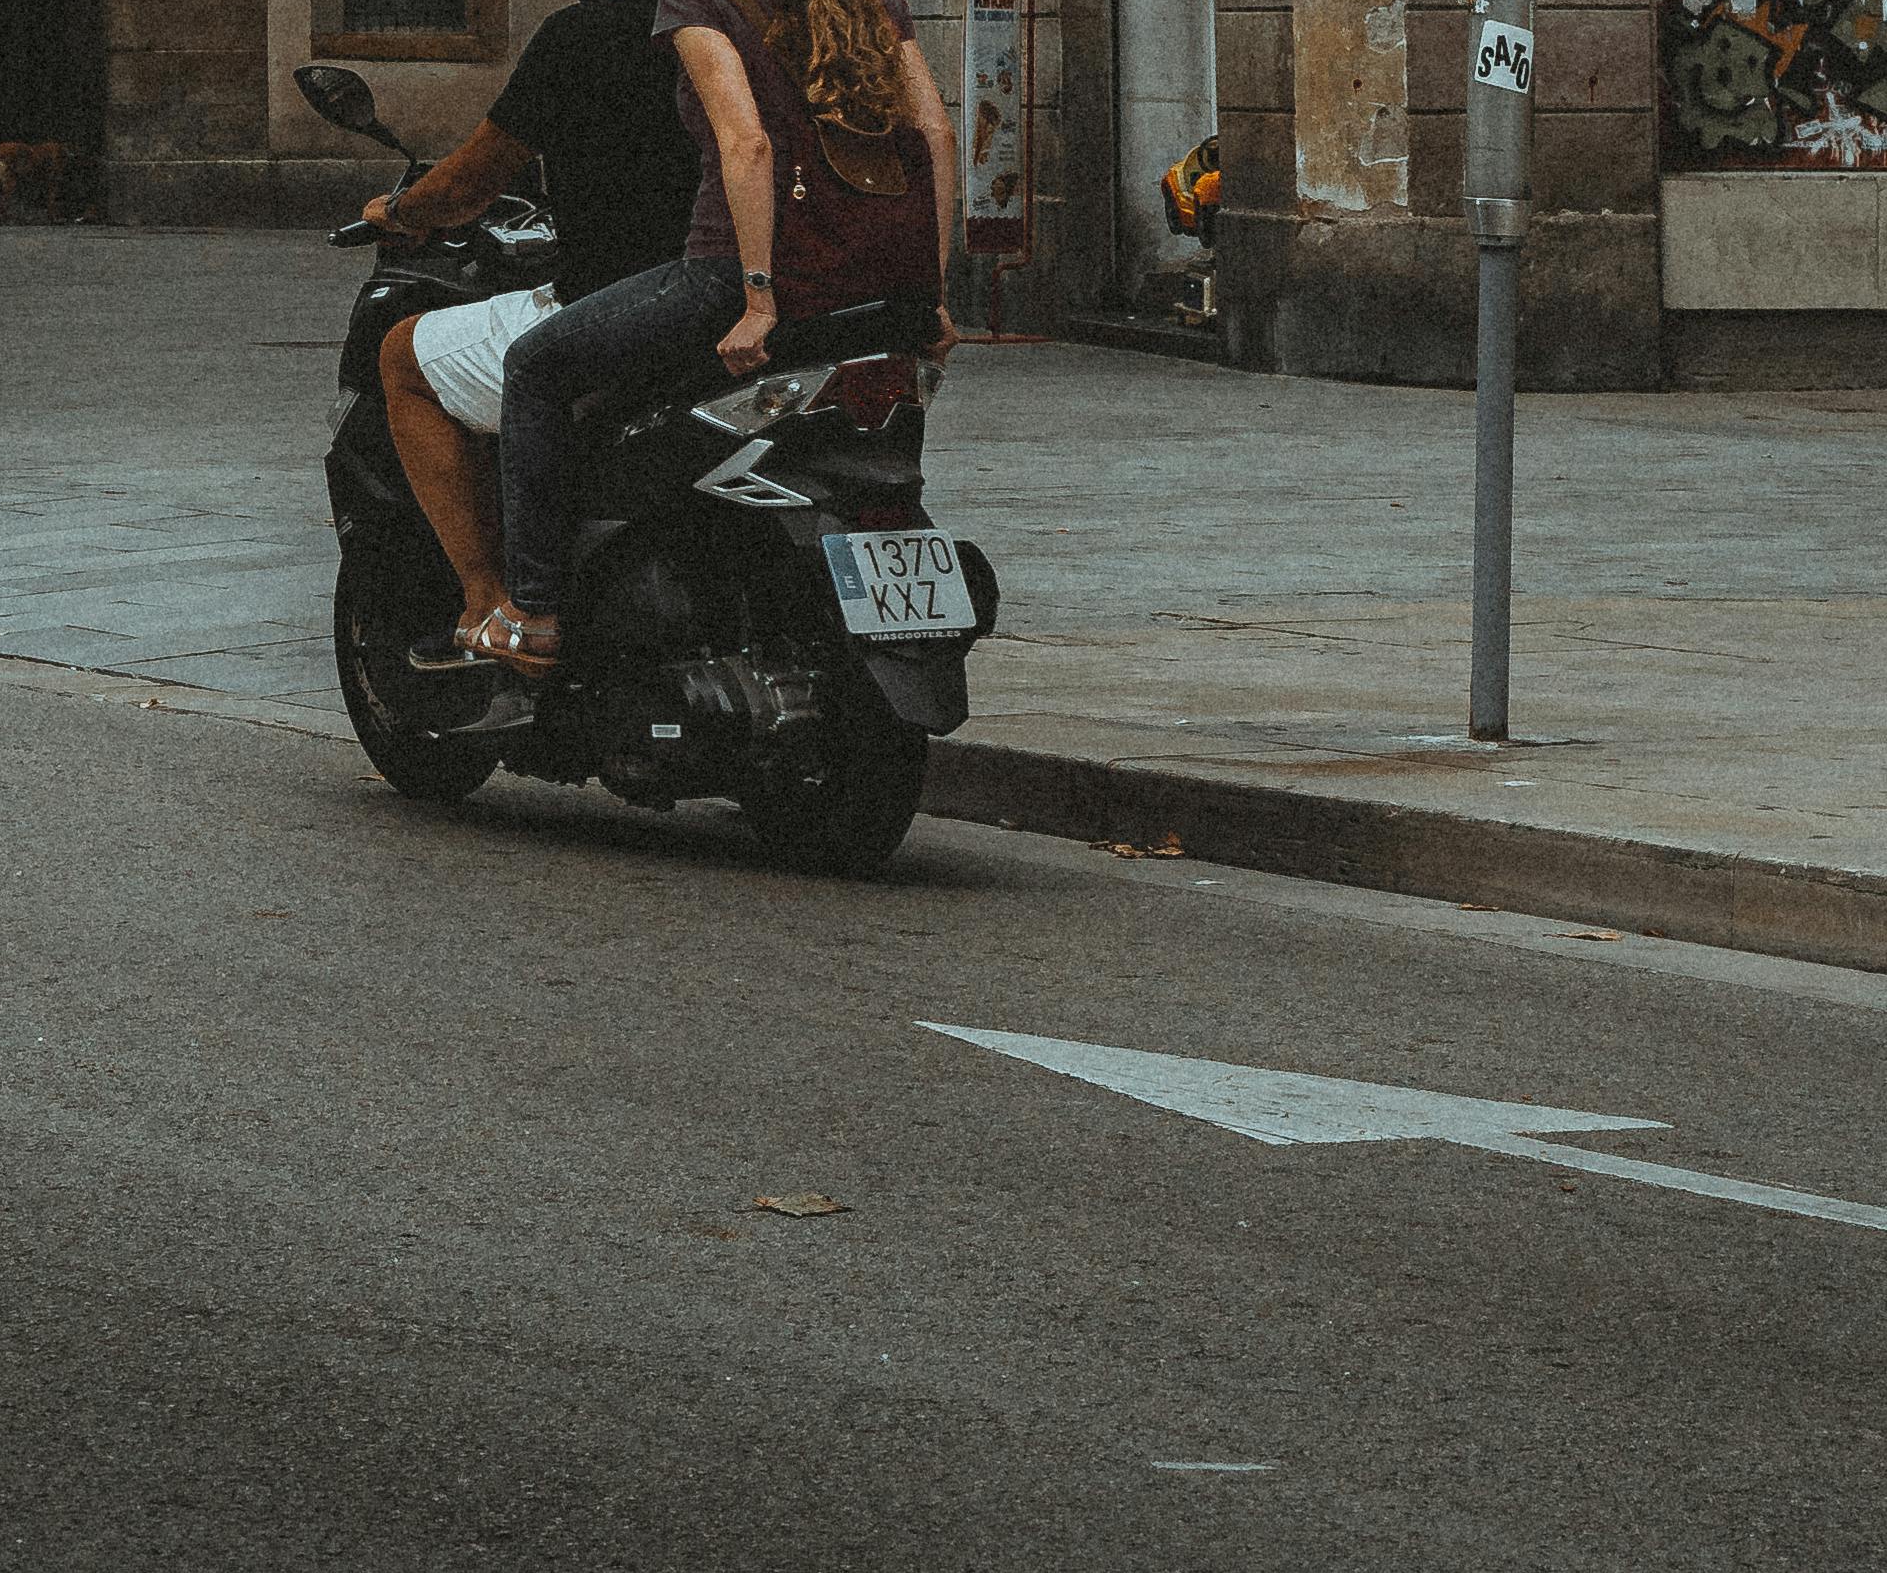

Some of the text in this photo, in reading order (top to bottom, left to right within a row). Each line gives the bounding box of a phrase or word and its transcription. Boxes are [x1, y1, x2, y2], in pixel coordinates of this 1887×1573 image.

[1478, 35, 1530, 89] SATO
[864, 536, 953, 578] 1370
[843, 575, 856, 589] E
[871, 581, 946, 623] KXZ
[870, 630, 961, 641] VIASCOOTER.ES
